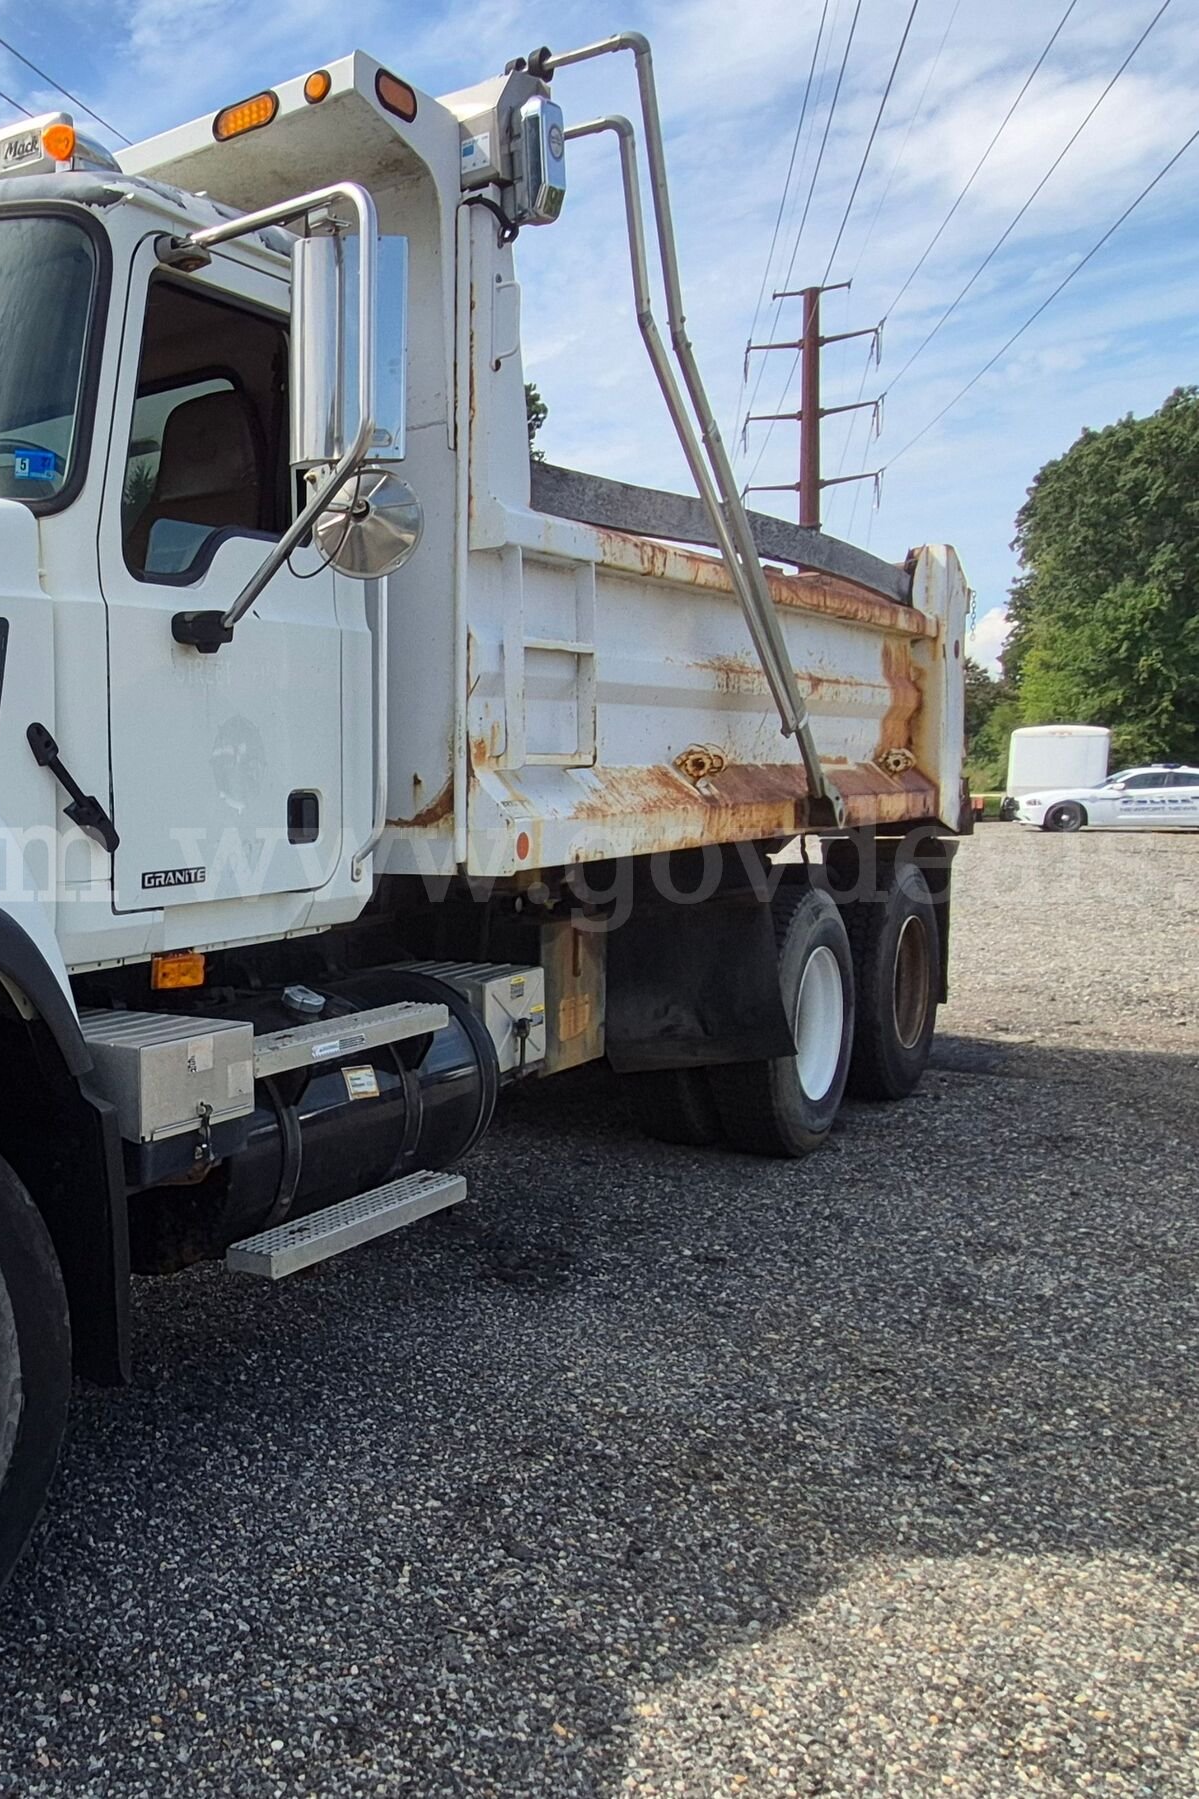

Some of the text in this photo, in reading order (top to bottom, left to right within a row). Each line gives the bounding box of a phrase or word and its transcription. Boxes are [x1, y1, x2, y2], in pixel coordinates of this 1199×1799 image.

[4, 136, 40, 160] Mack
[20, 458, 27, 471] 5
[144, 869, 205, 887] GRANITE
